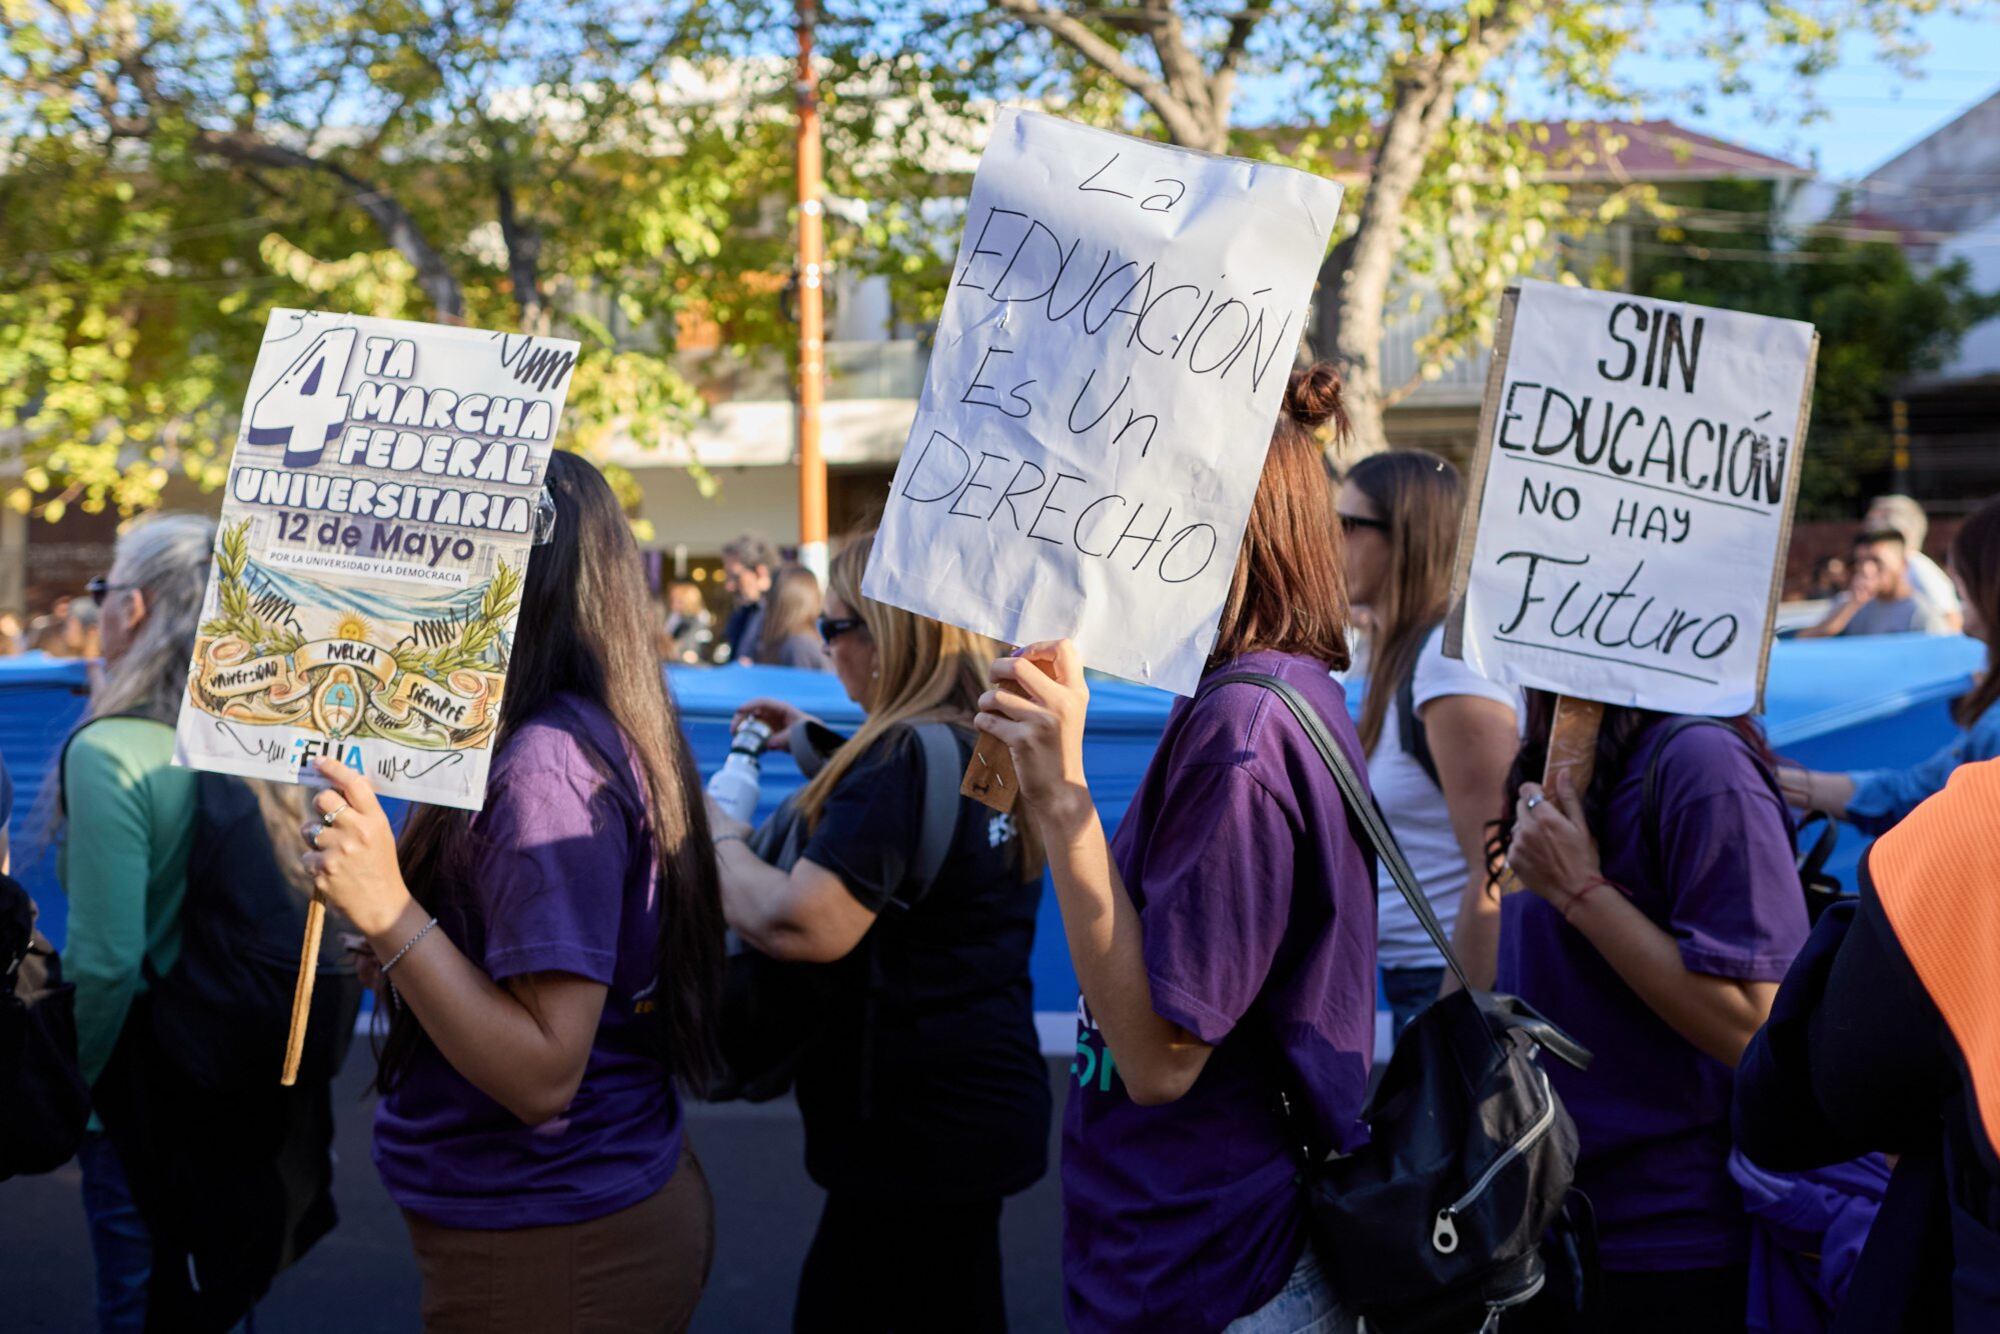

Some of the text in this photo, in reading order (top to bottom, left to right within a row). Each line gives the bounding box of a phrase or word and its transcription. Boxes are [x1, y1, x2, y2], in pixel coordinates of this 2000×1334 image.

[1078, 152, 1187, 213] La
[956, 206, 1293, 393] EDUCACIÓN
[1597, 301, 1705, 394] SIN
[248, 327, 416, 468] 4 TA
[350, 380, 553, 442] MARCHA
[960, 346, 1160, 458] Es Un
[338, 425, 534, 486] FEDERAL
[1498, 380, 1789, 505] EDUCACIÓN
[233, 465, 531, 534] UNIVERSITARIA
[276, 511, 476, 568] 12 de Mayo
[901, 430, 1217, 583] DERECHO
[1518, 477, 1691, 544] NO HAY
[269, 551, 462, 583] POR LA UNIVERSIDAD Y LA DEMOCRACIA
[1496, 551, 1739, 660] Futuro
